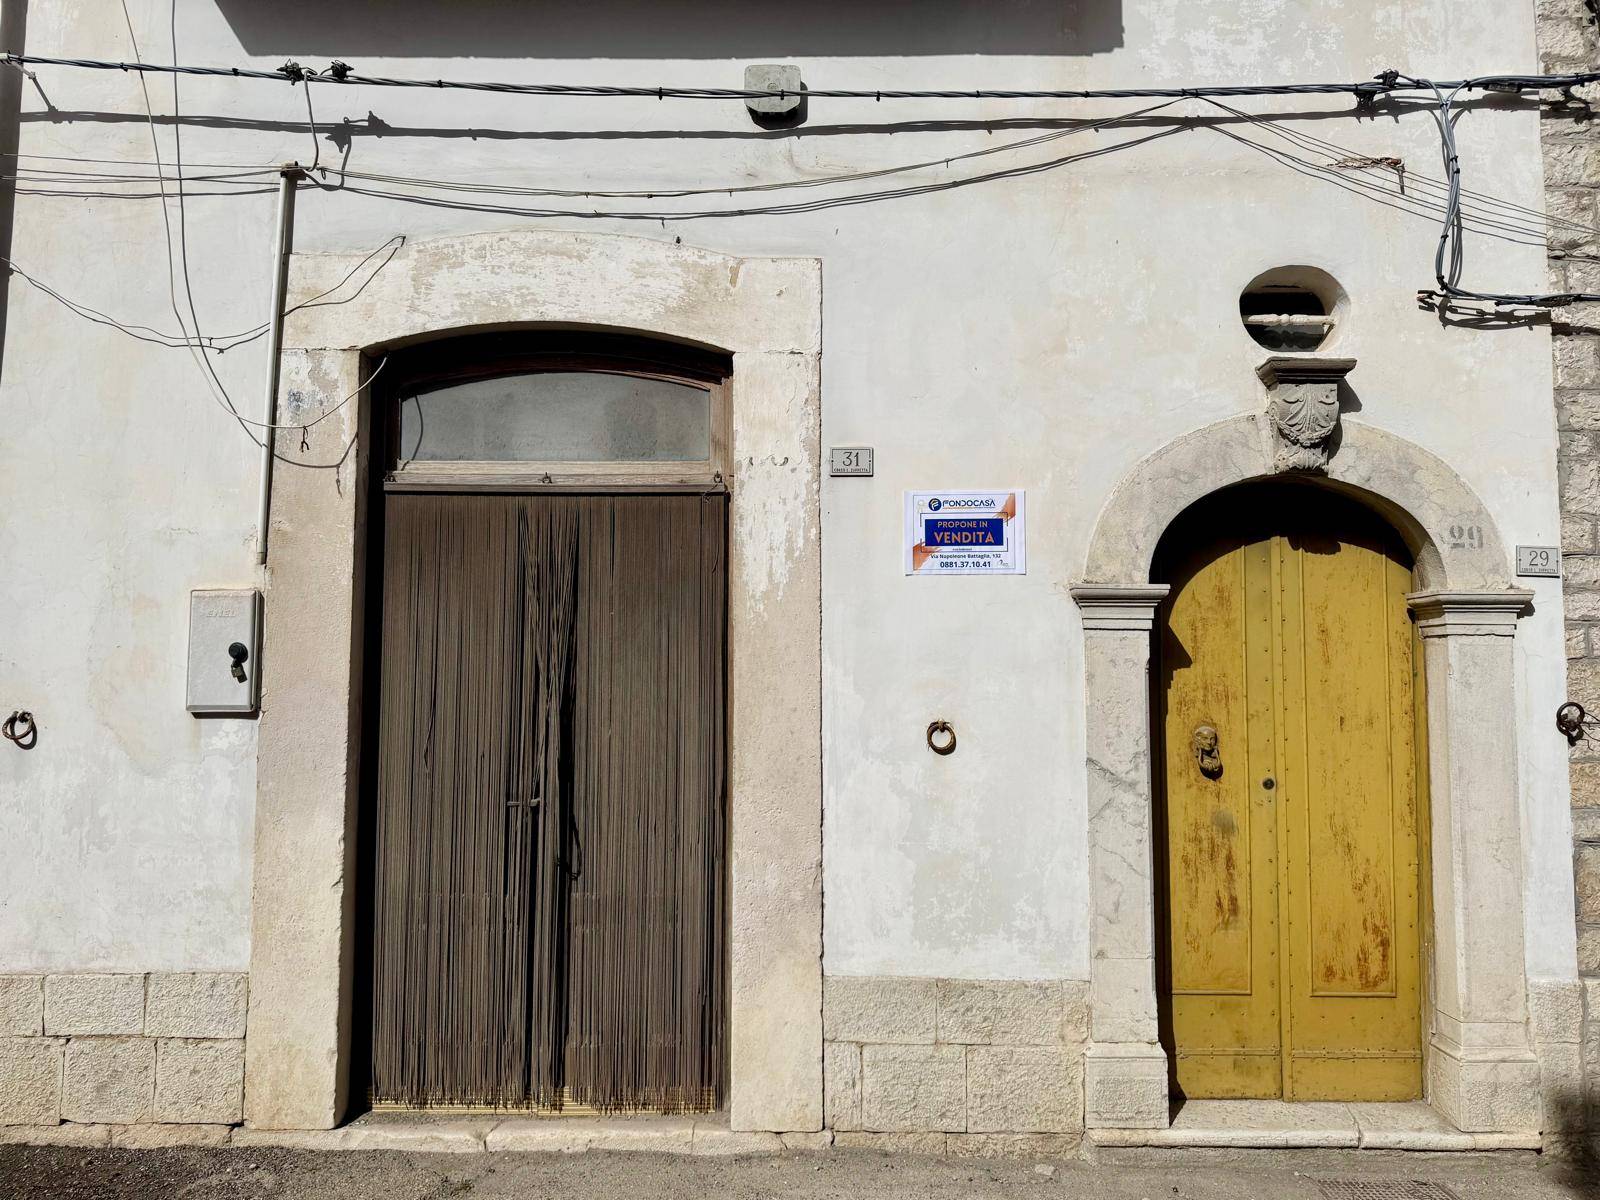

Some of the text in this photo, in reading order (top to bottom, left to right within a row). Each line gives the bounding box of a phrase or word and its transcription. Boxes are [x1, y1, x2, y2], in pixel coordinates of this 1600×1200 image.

[842, 451, 860, 467] 31
[942, 499, 996, 507] FONDOCASA
[934, 531, 995, 544] VENDITA
[1529, 550, 1549, 567] 29
